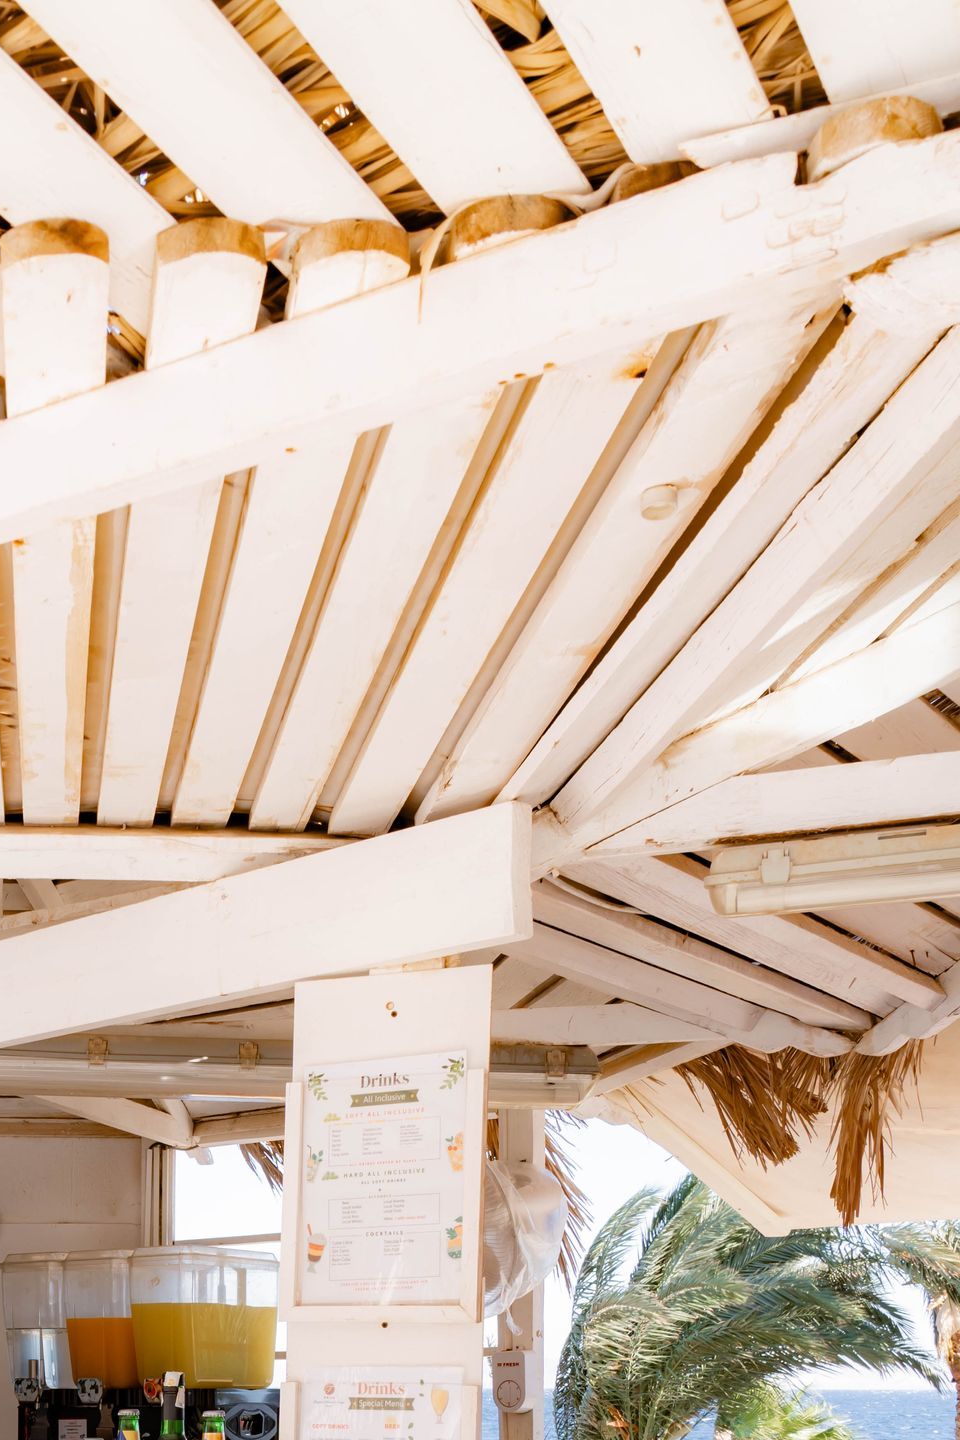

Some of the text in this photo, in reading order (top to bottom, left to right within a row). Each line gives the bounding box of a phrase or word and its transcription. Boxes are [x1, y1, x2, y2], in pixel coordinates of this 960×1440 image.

[360, 1072, 410, 1088] Drinks
[363, 1093, 406, 1104] All Inclusive
[343, 1171, 364, 1179] HARD
[384, 1167, 425, 1176] INCLUSIVE
[357, 1381, 406, 1395] Drinks
[359, 1399, 404, 1408] Special Menu
